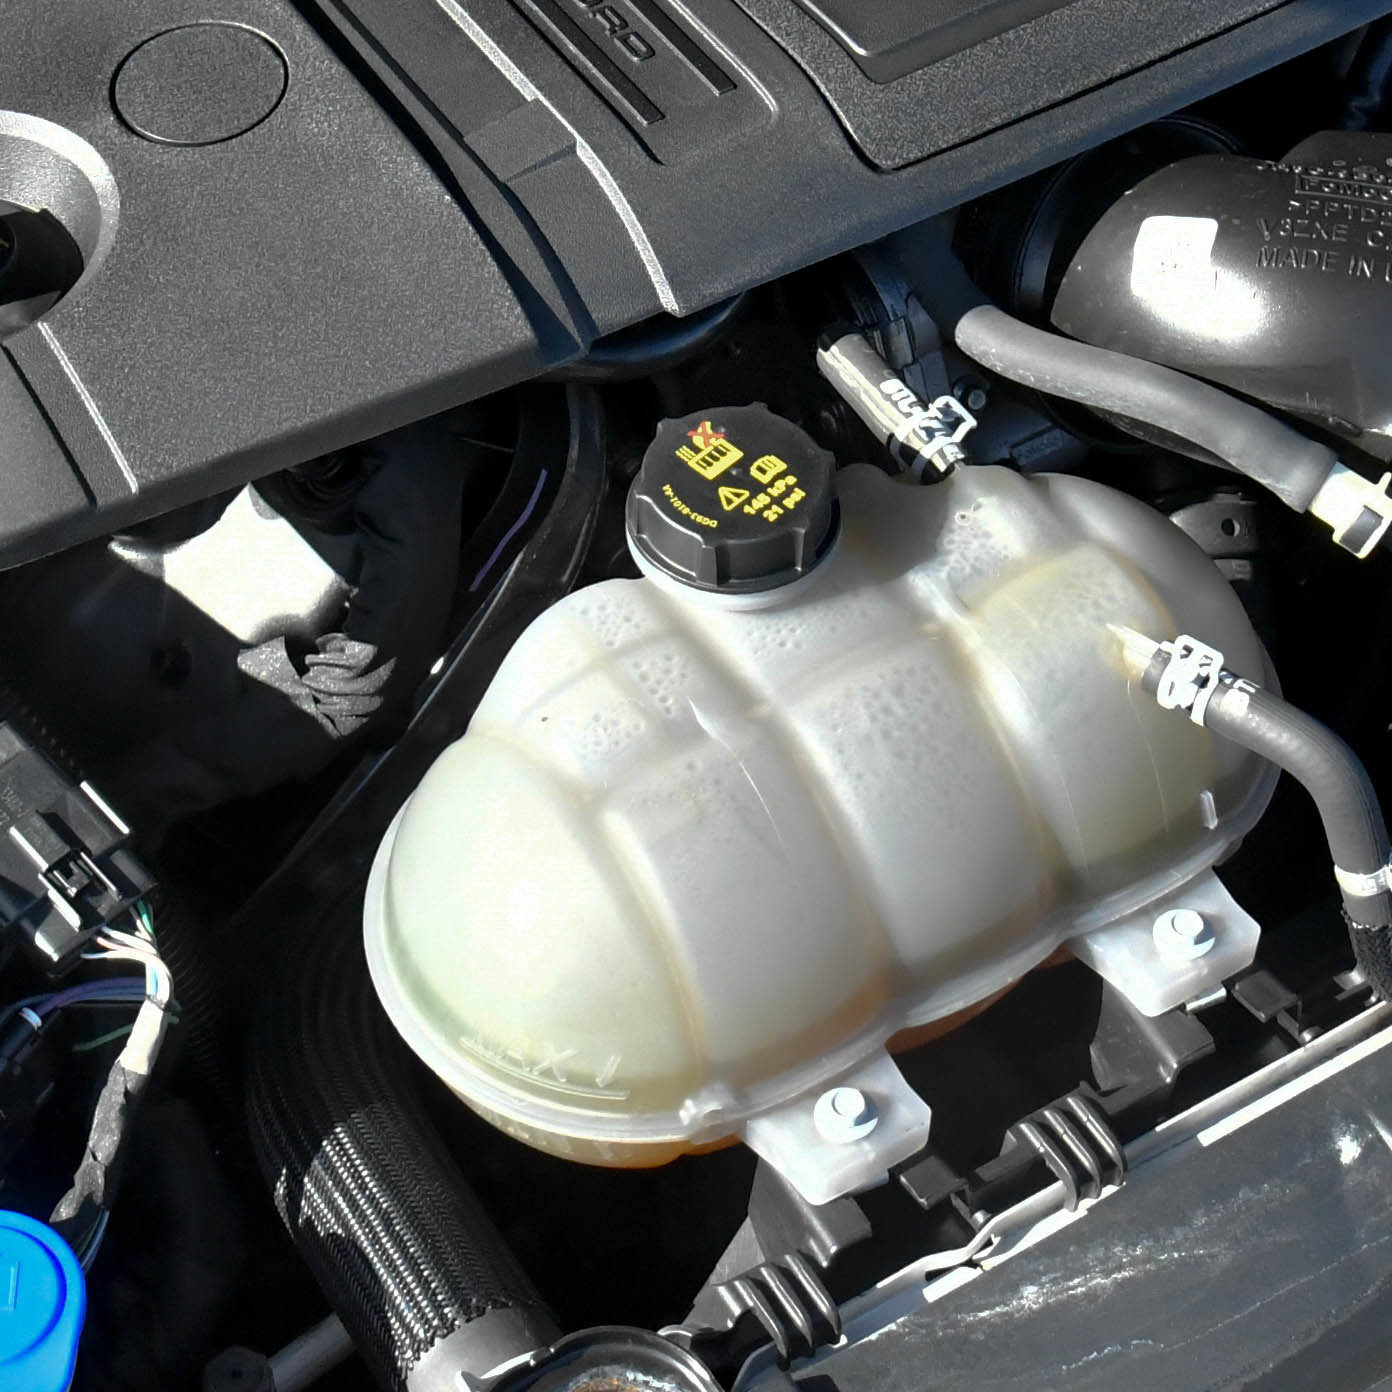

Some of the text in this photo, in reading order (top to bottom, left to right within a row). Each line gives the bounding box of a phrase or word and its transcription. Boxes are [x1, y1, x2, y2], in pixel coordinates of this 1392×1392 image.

[1255, 245, 1339, 273] MADE
[1348, 255, 1375, 279] IN
[743, 493, 771, 515] 145
[762, 487, 806, 523] 21 psi
